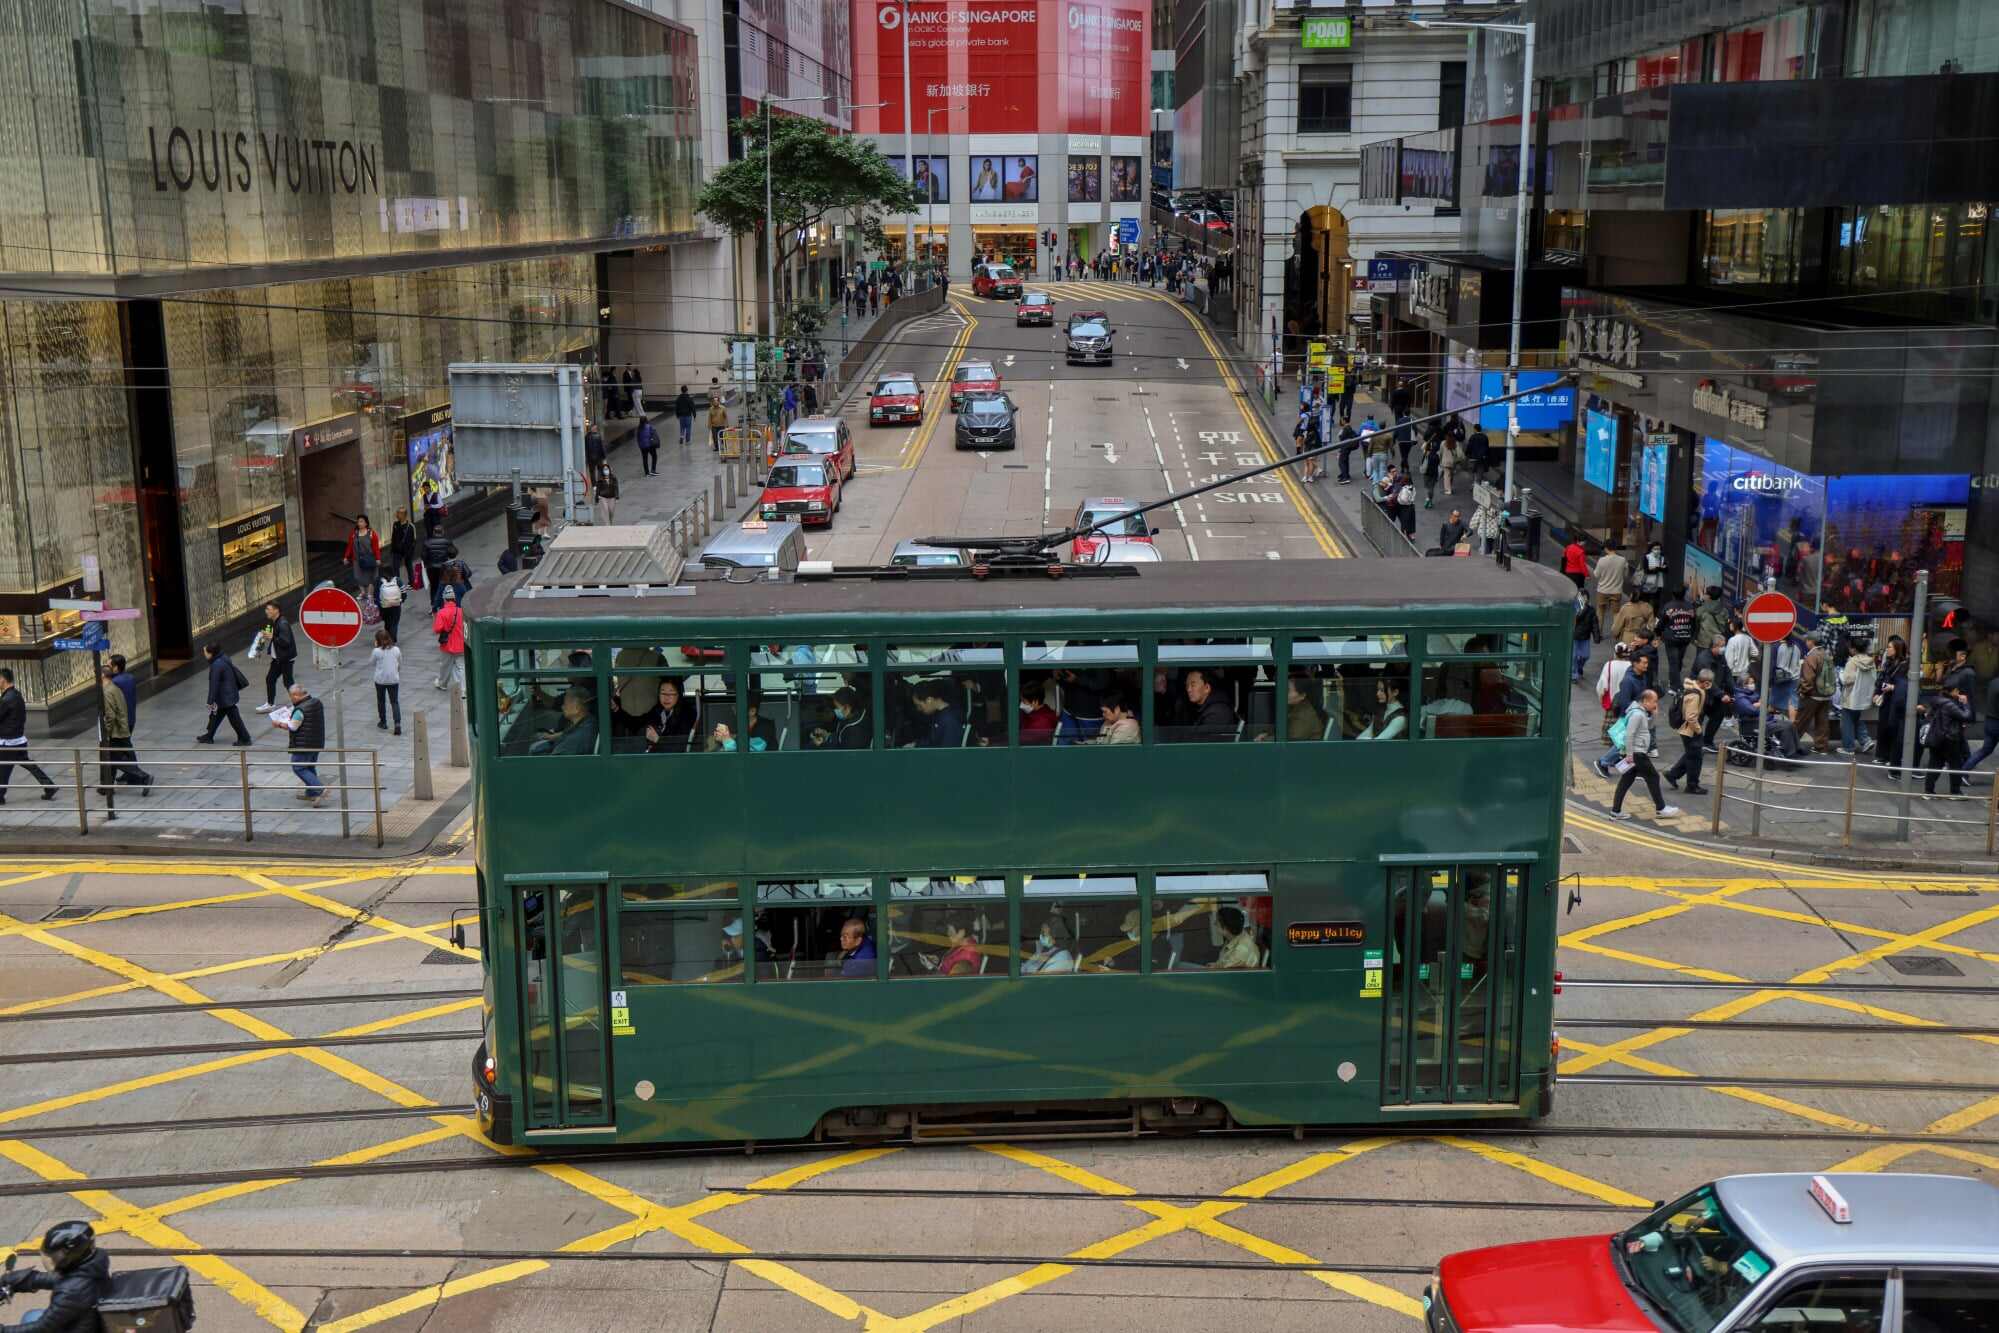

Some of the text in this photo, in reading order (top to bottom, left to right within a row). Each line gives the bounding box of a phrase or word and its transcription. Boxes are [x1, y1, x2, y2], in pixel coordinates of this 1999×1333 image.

[1306, 22, 1346, 38] POAD
[987, 37, 1009, 47] bank
[927, 83, 991, 97] 新加坡銀行
[149, 126, 378, 194] LOUIS VUITTON
[1733, 474, 1803, 490] citibank
[1213, 493, 1283, 502] BUS
[1288, 927, 1362, 939] Happy Valley
